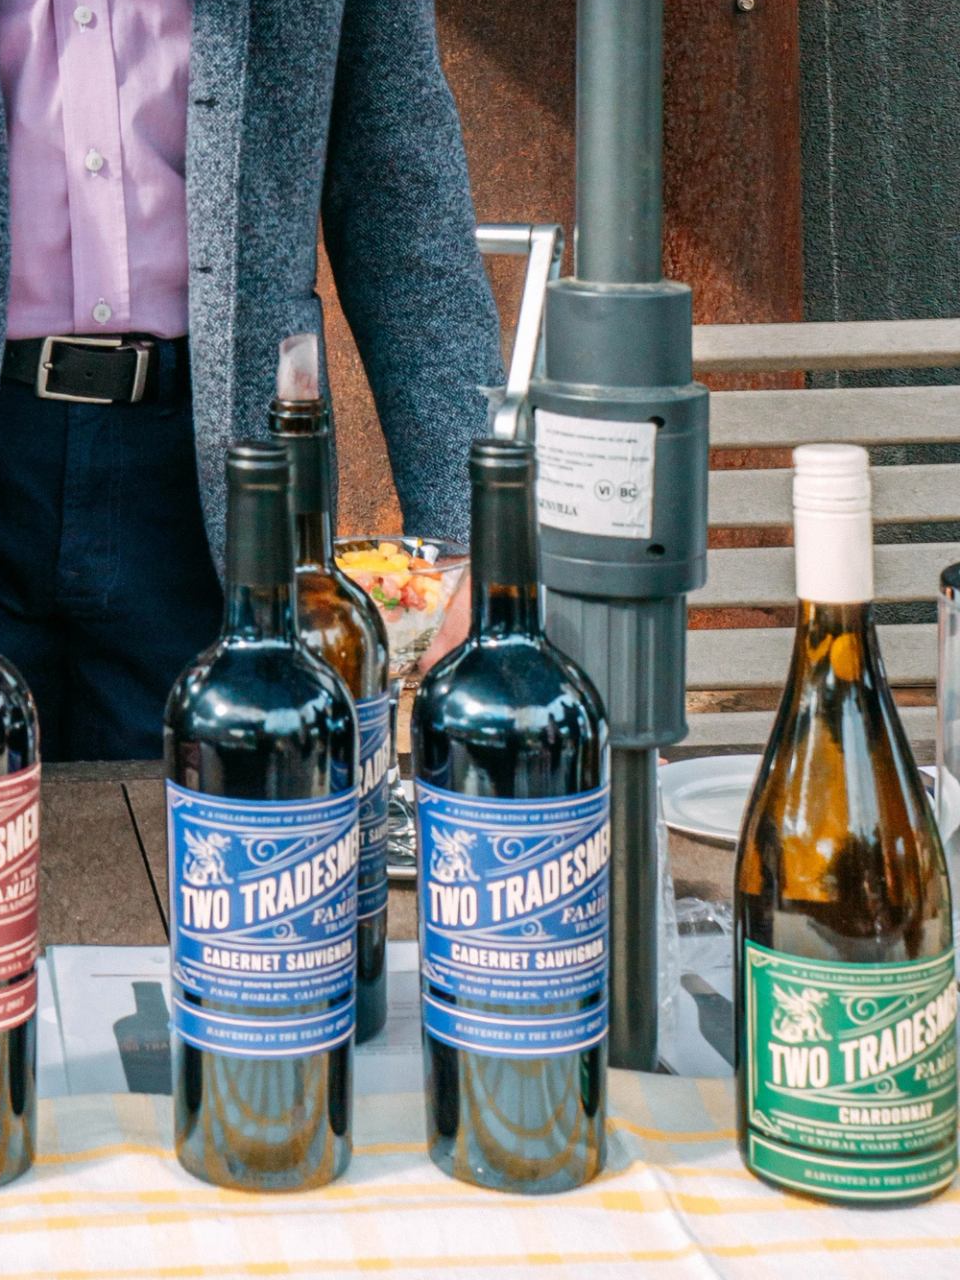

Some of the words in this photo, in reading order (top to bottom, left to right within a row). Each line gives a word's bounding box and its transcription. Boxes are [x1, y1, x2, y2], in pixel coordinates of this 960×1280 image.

[620, 487, 637, 498] BC
[180, 885, 230, 929] TWO
[239, 822, 359, 924] TRADESME
[428, 881, 477, 926] TWO
[487, 821, 611, 923] TRADESME
[311, 897, 356, 927] FAMI
[560, 894, 607, 925] FAMI
[203, 945, 281, 971] CABERNET
[286, 938, 352, 971] SAUVIGNON
[451, 943, 530, 970] CABERNET
[535, 937, 604, 970] SAUVIGNON
[768, 1041, 830, 1089] TWO
[838, 979, 958, 1084] TRADESM
[838, 1101, 934, 1125] CHARDONNAY
